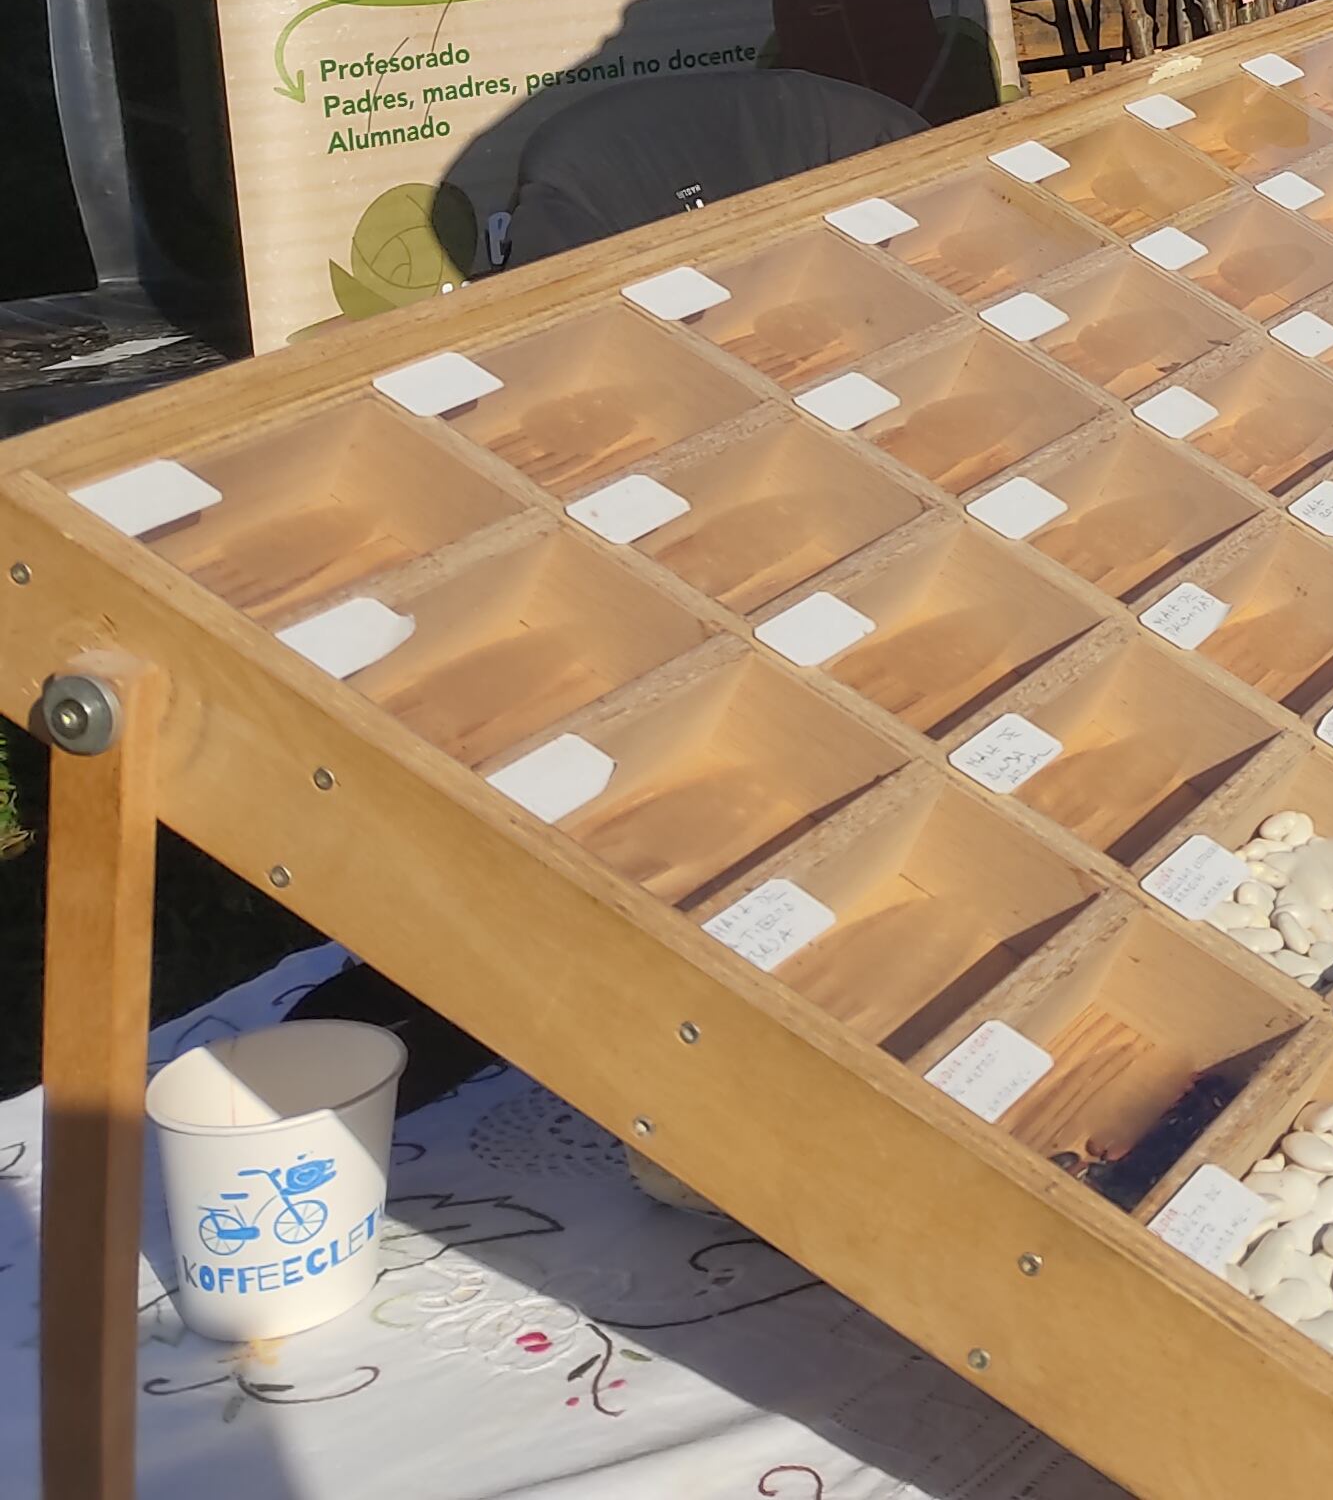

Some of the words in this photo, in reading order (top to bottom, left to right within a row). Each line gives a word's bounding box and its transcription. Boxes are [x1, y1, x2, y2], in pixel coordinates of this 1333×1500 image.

[319, 46, 470, 81] Profesorado
[323, 87, 414, 120] Padres,
[423, 75, 518, 106] madres,
[526, 58, 627, 95] personal
[633, 53, 661, 73] no
[667, 44, 756, 70] docente
[327, 116, 451, 155] Alumnado
[182, 1202, 386, 1295] KOFFEECLET
